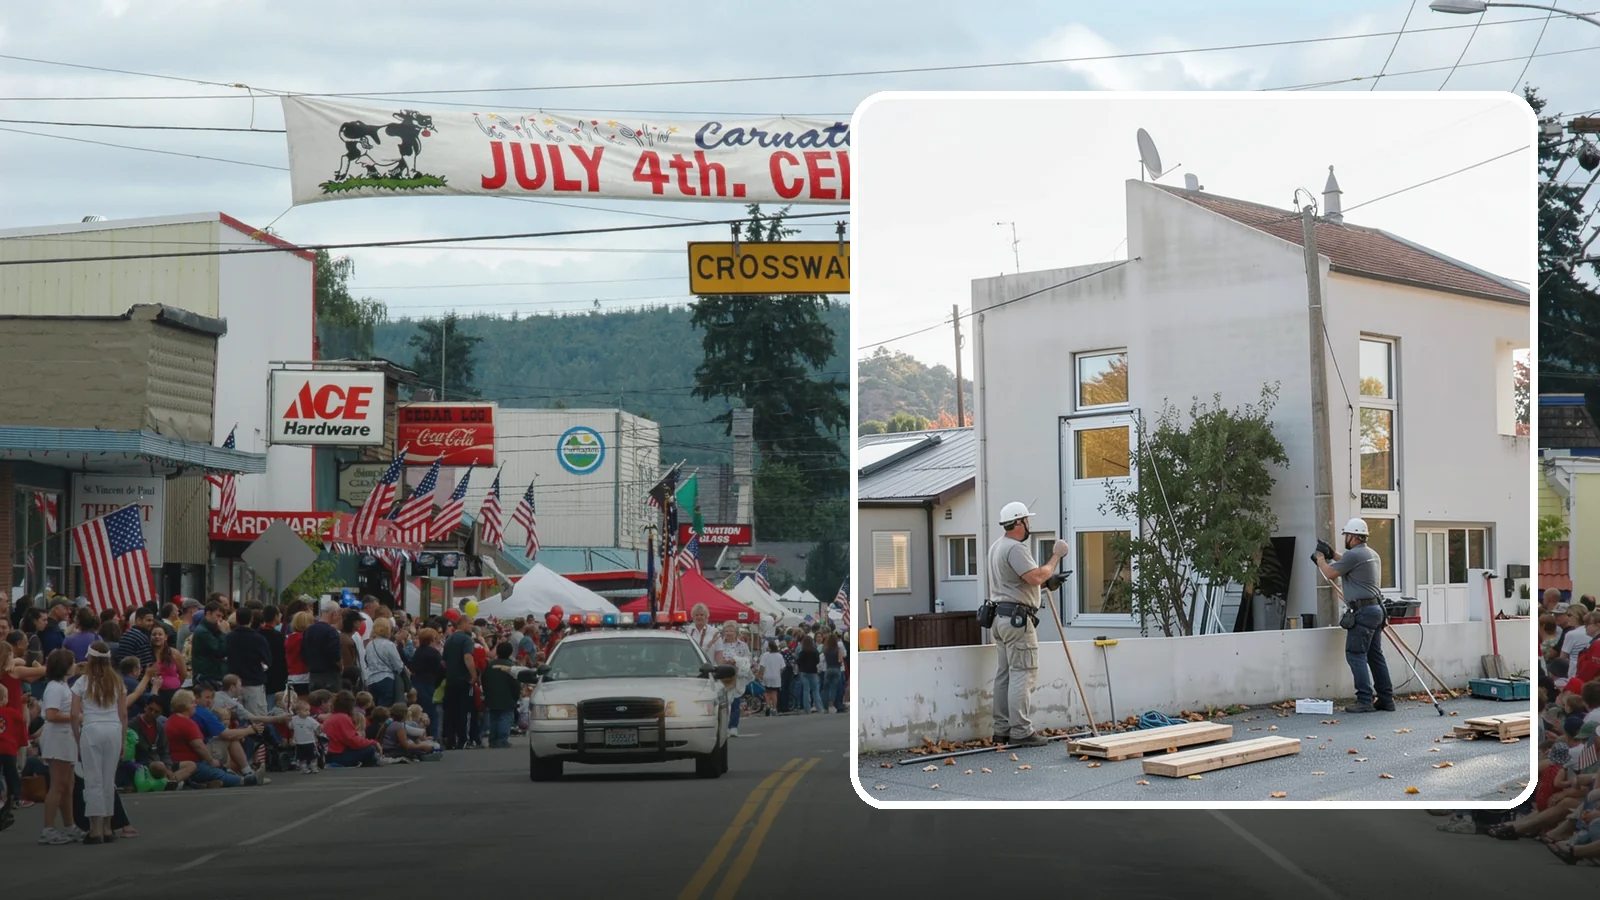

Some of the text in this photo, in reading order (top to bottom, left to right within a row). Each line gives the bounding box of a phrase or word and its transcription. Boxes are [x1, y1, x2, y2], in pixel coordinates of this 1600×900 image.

[481, 140, 604, 192] JULY
[632, 150, 746, 197] 4th.
[696, 254, 850, 280] CROSSWA
[283, 380, 373, 420] ACE
[405, 409, 452, 422] CEDAR
[283, 421, 371, 436] Hardware
[95, 485, 125, 495] Vincent
[126, 485, 136, 495] de
[137, 486, 155, 496] Paul
[688, 526, 741, 535] CRNATION
[699, 535, 730, 543] GLASS
